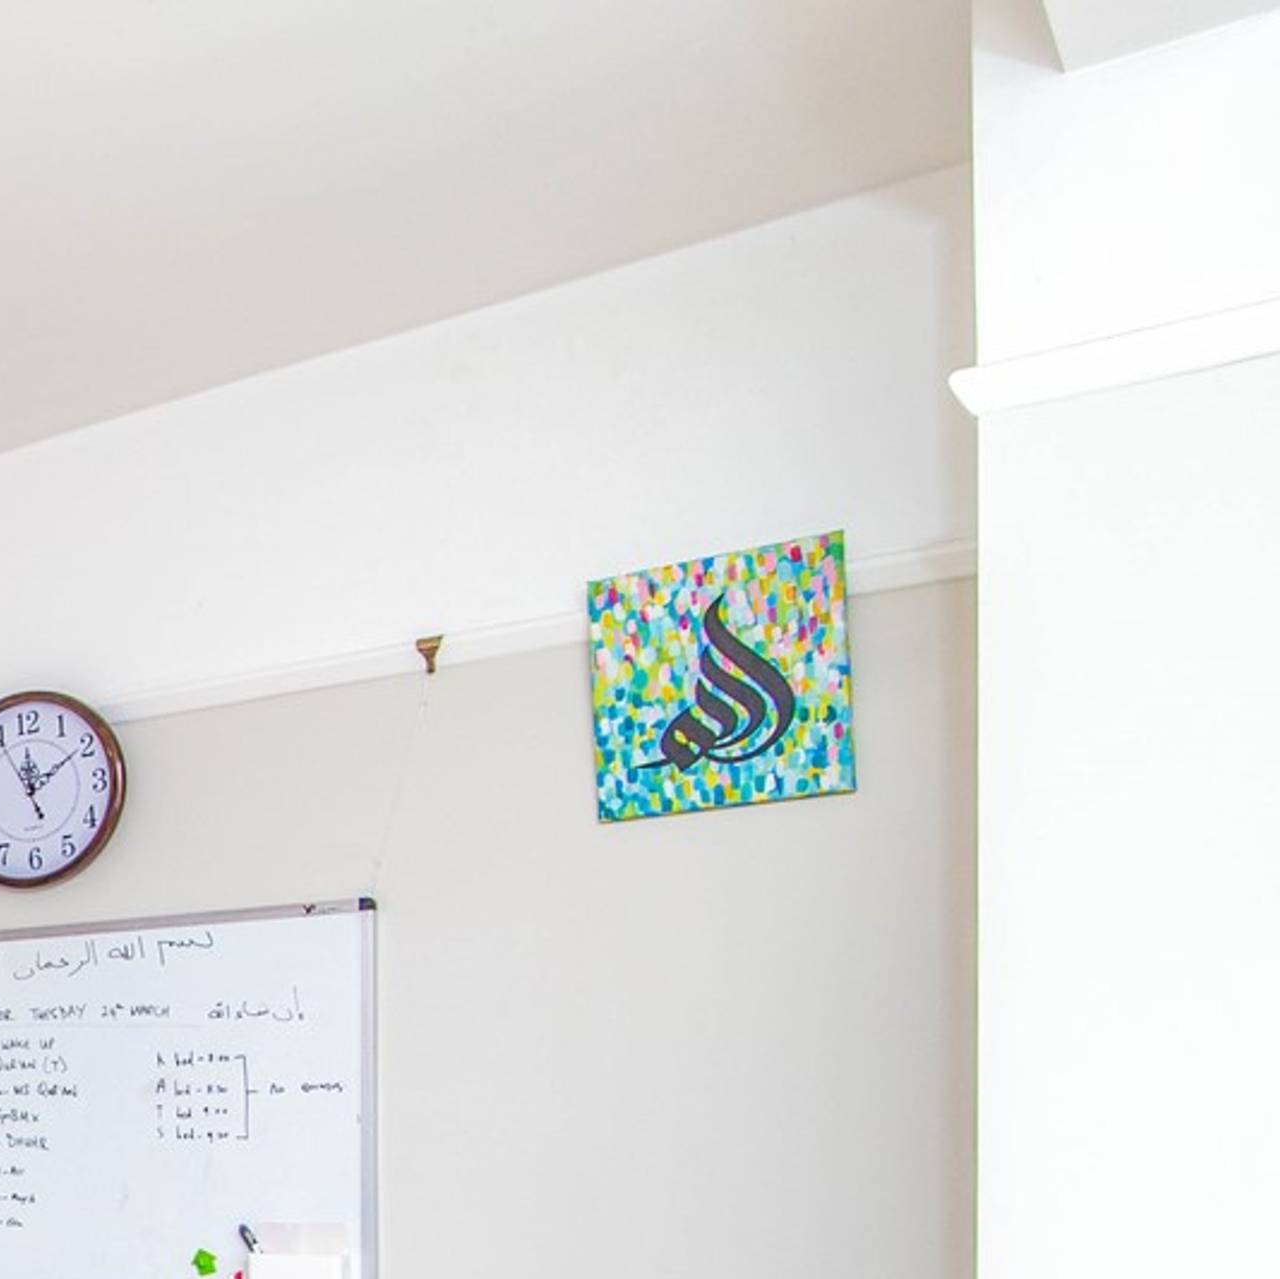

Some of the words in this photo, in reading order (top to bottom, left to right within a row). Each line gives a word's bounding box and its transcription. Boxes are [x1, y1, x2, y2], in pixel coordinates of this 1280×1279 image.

[17, 710, 40, 735] 12
[57, 714, 65, 737] 1
[80, 733, 95, 758] 2
[92, 768, 108, 792] 3
[83, 805, 98, 828] 4
[61, 835, 75, 857] 5
[29, 847, 42, 870] 6
[30, 1004, 88, 1021] TUESDAY
[130, 1004, 171, 1018] MARCH
